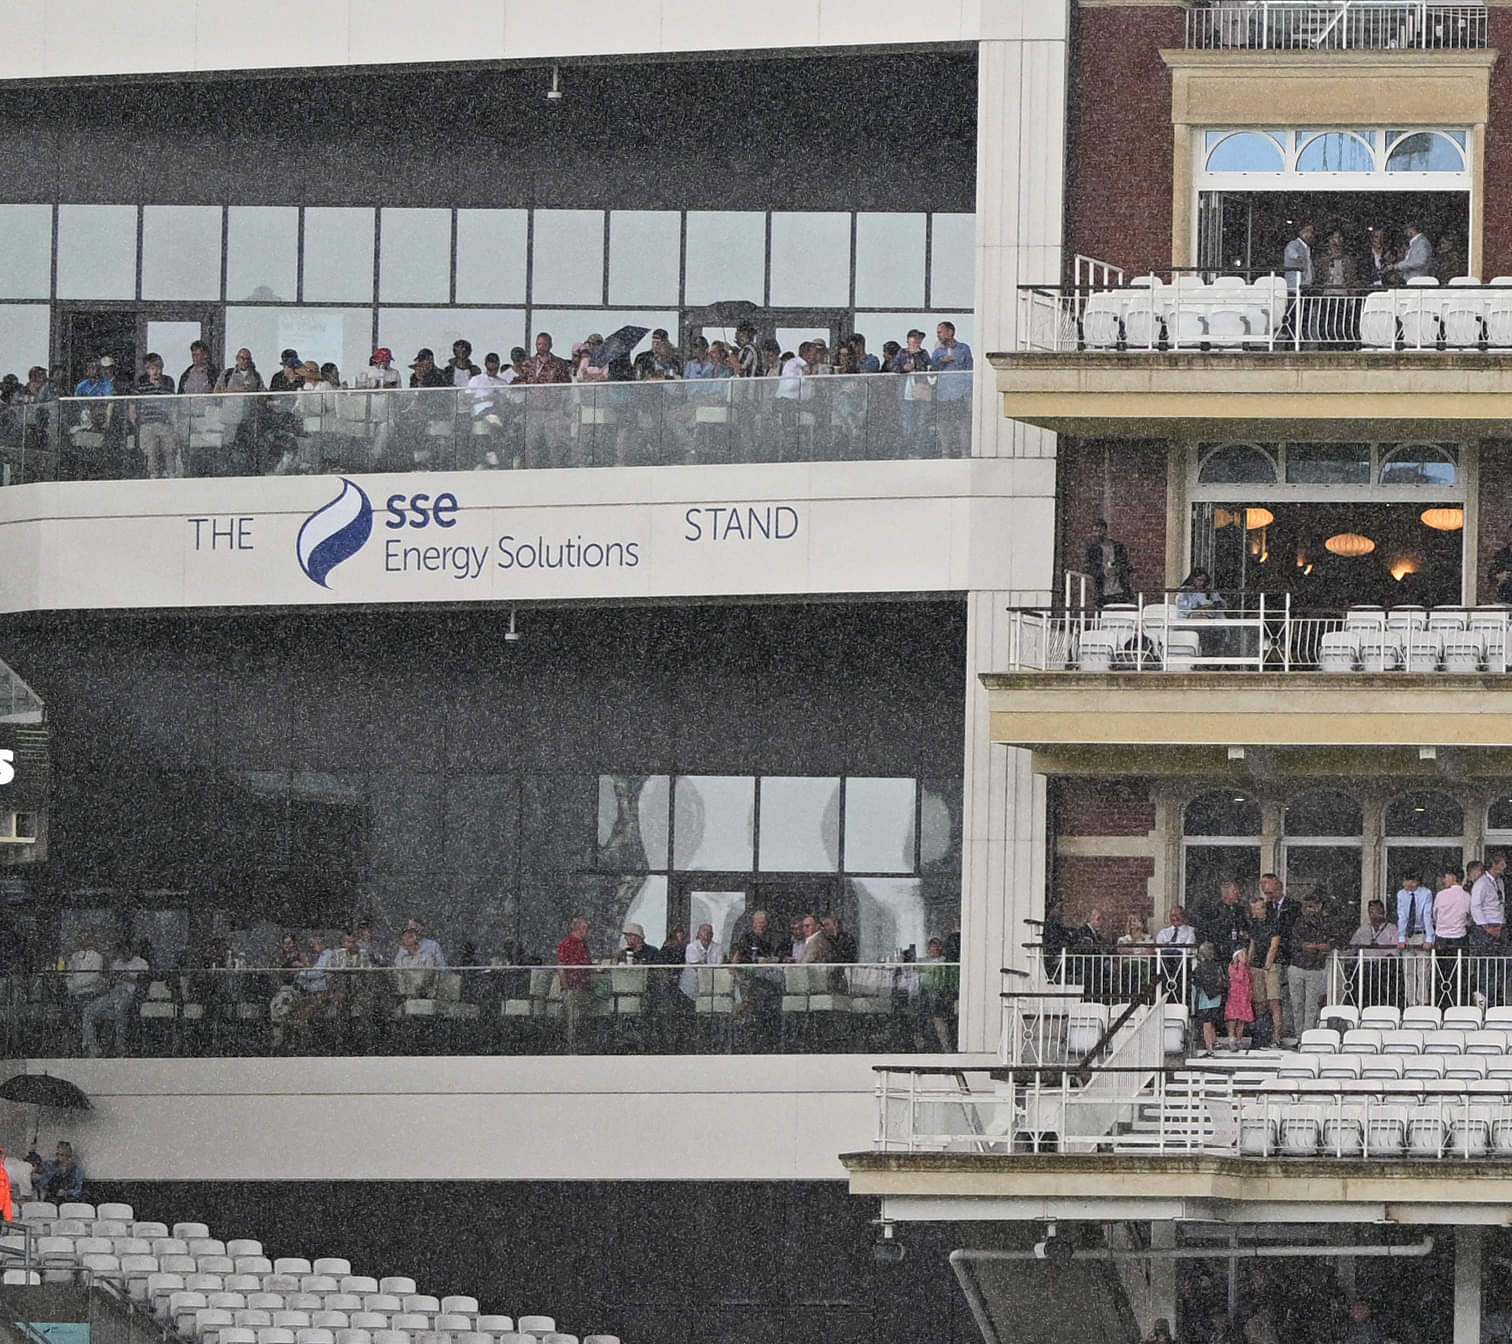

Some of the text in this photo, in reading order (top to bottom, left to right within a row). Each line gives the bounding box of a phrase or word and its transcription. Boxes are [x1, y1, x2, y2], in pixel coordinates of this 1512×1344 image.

[386, 492, 458, 529] sse
[685, 506, 798, 542] STAND
[188, 517, 254, 551] THE
[385, 535, 640, 579] Energy Solutions
